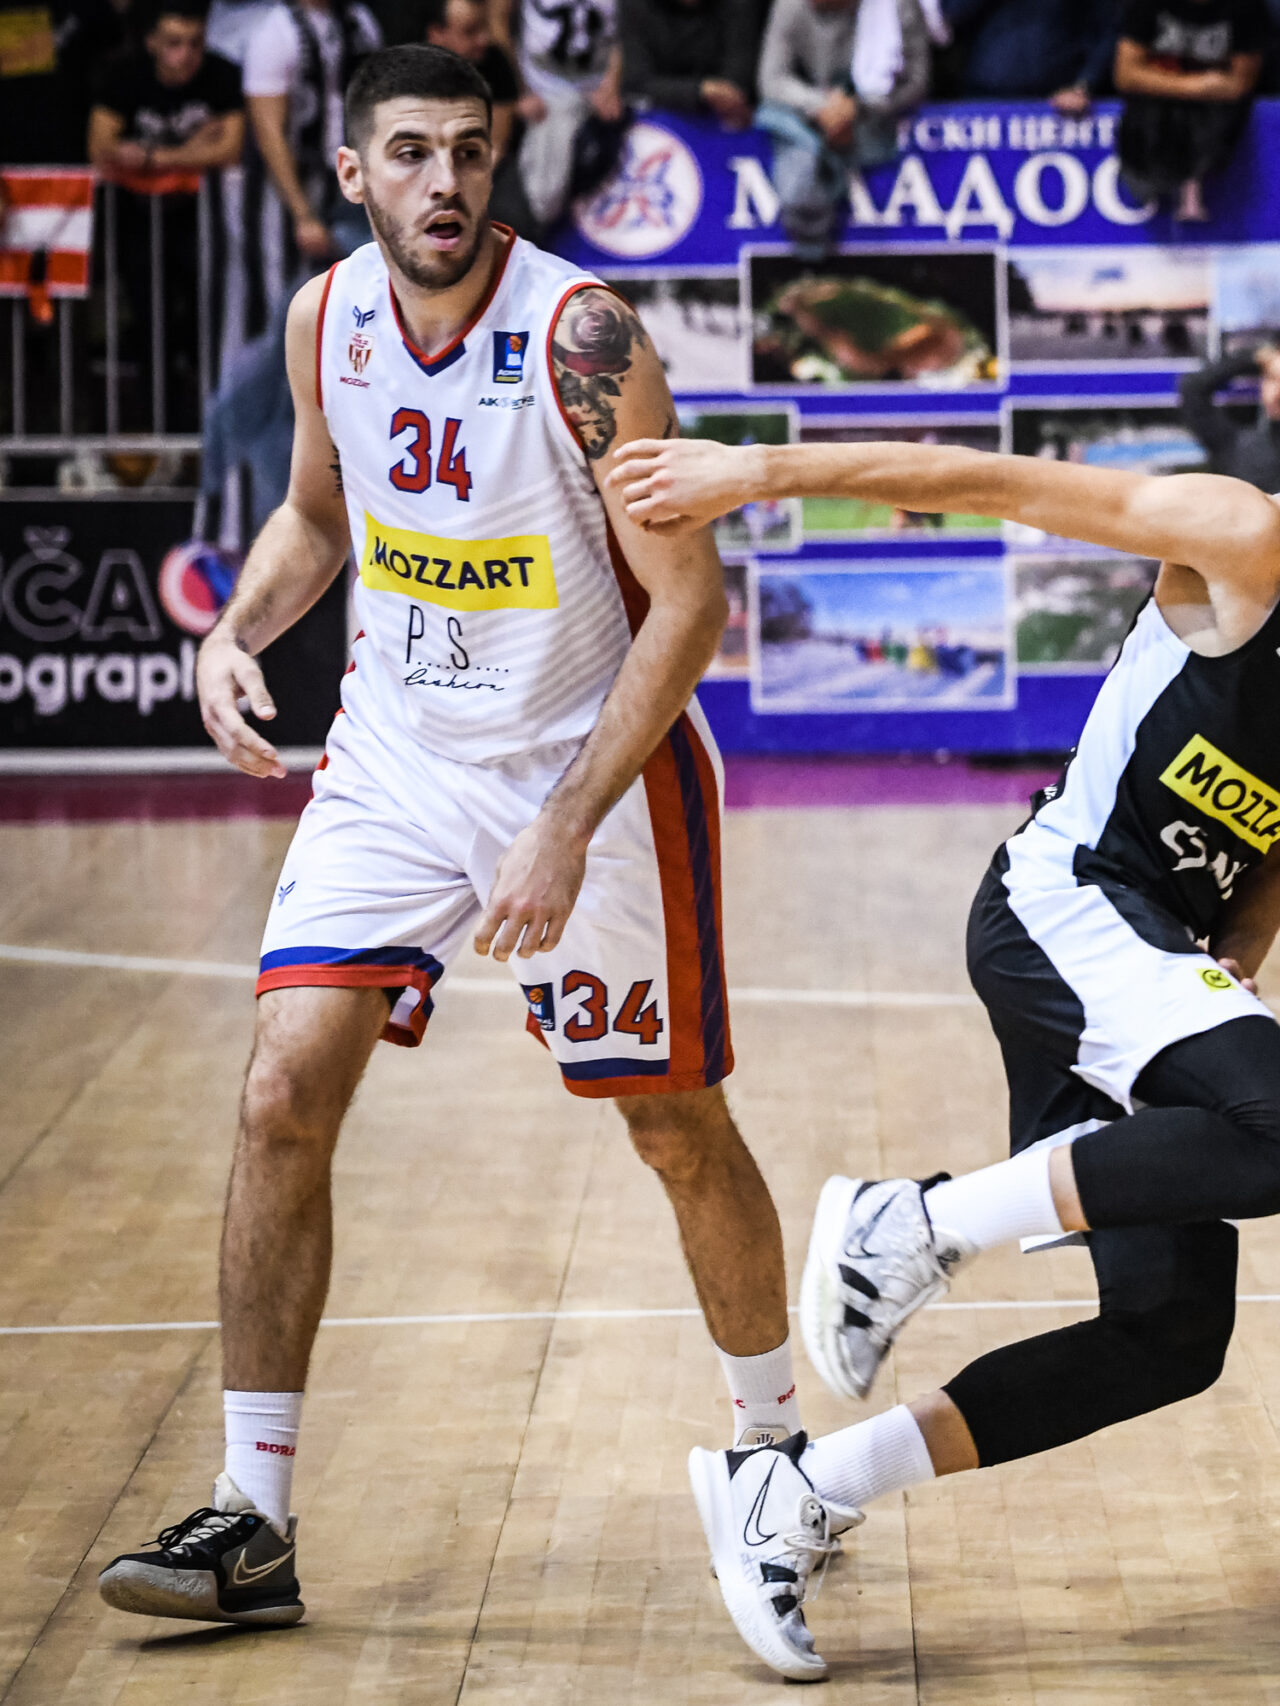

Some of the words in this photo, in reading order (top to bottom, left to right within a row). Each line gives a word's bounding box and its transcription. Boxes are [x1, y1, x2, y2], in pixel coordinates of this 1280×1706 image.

[388, 406, 474, 502] 34
[369, 536, 535, 591] MOZZART
[561, 969, 664, 1046] 34
